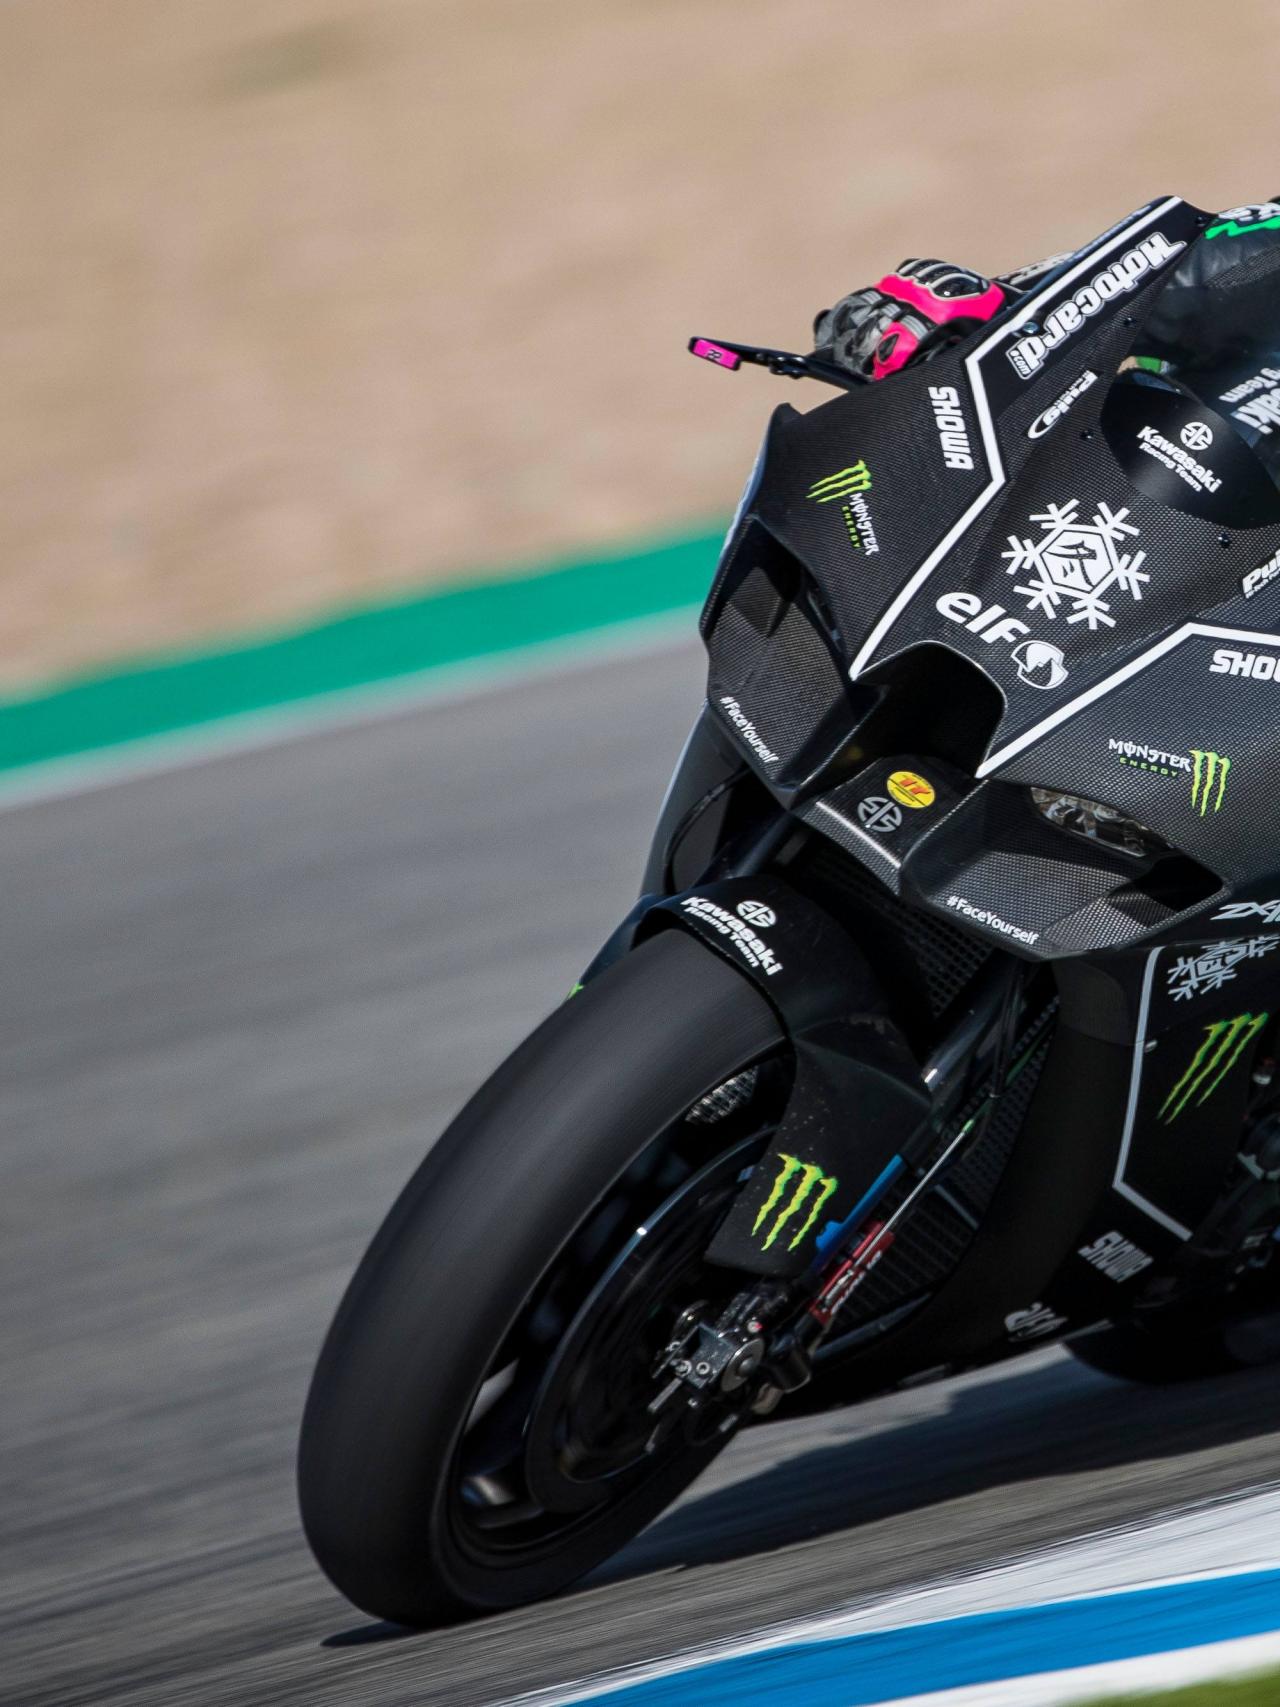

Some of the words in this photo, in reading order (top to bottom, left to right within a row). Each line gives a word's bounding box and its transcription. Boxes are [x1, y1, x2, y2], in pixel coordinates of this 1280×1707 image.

[927, 386, 975, 470] SHOWA
[1136, 425, 1223, 494] Kawasaki
[1139, 442, 1178, 470] Racing
[1174, 464, 1204, 492] Team
[849, 492, 880, 556] MONSTER
[935, 591, 1031, 645] elf
[720, 696, 779, 763] #FaceYourself
[1108, 738, 1192, 772] MONSTER
[1119, 757, 1178, 777] ENERGY
[680, 896, 784, 976] Kawasaki
[946, 895, 1040, 945] #FaceYourself
[729, 931, 760, 968] Team
